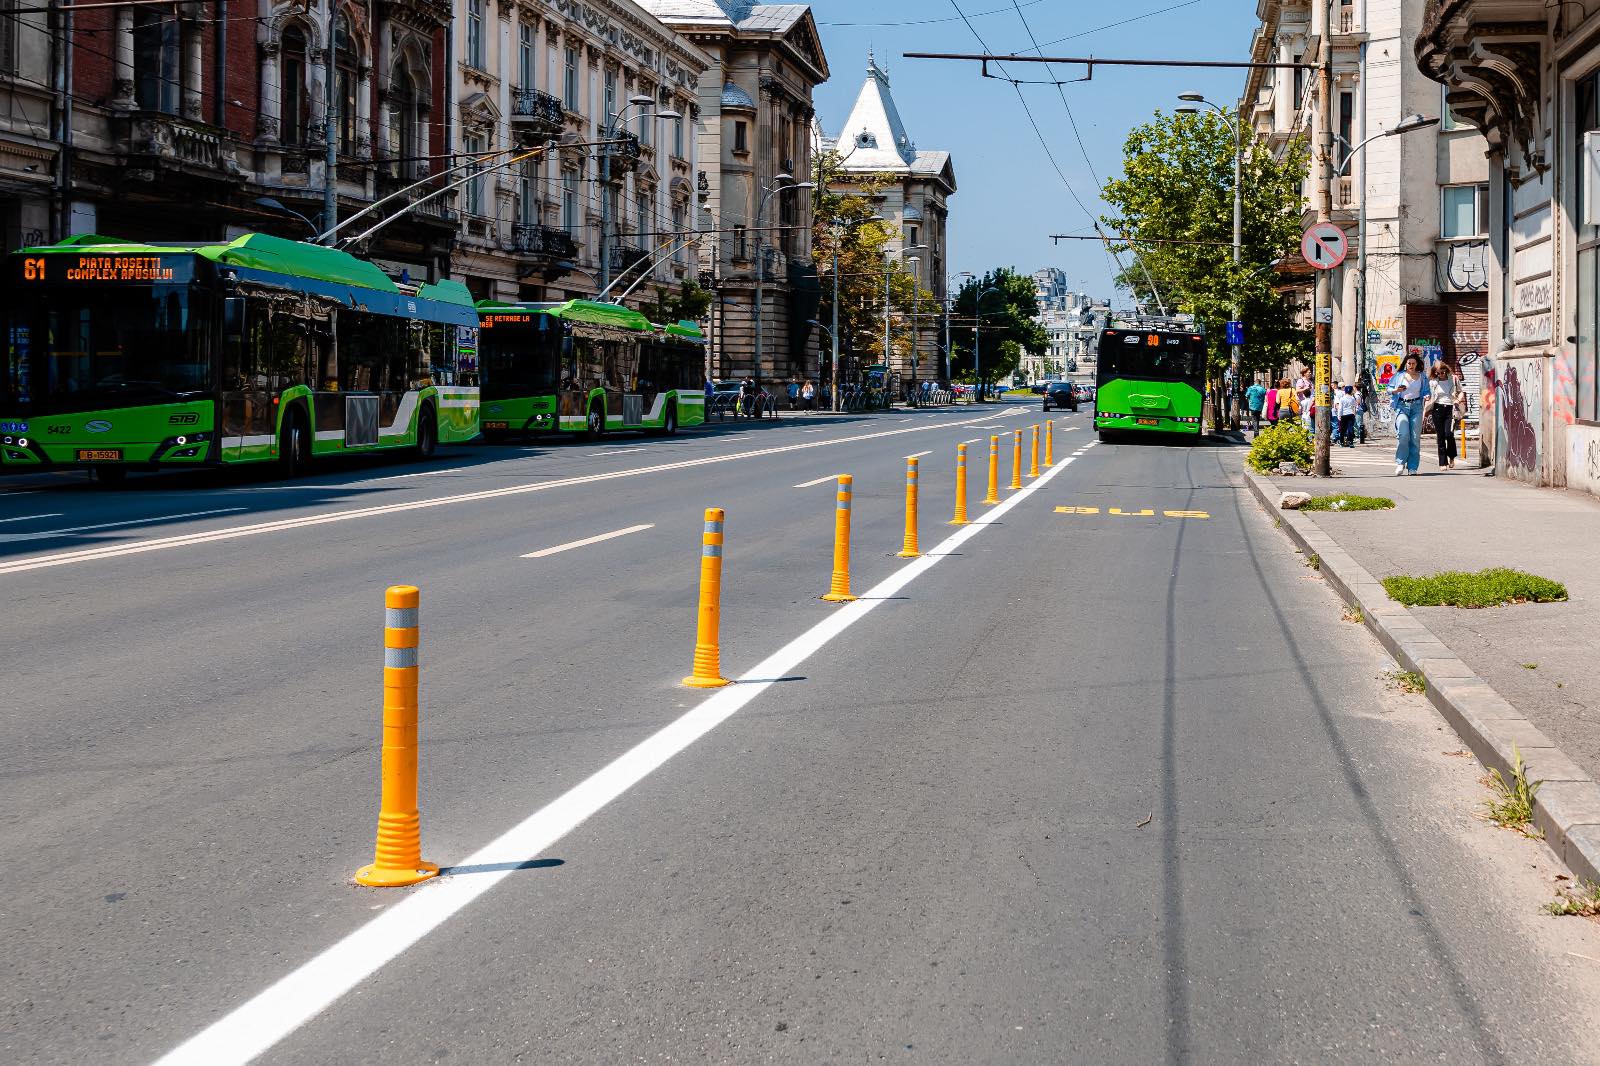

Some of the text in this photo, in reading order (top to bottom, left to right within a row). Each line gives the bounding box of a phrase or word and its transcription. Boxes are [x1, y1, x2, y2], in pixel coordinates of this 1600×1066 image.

[24, 258, 46, 280] 61
[115, 257, 161, 269] ROSETTI
[67, 268, 173, 280] COMPLEX APUSULUI
[168, 413, 200, 426] STB
[47, 425, 72, 434] 5422
[96, 451, 118, 459] 15921
[1052, 506, 1211, 519] BUS
